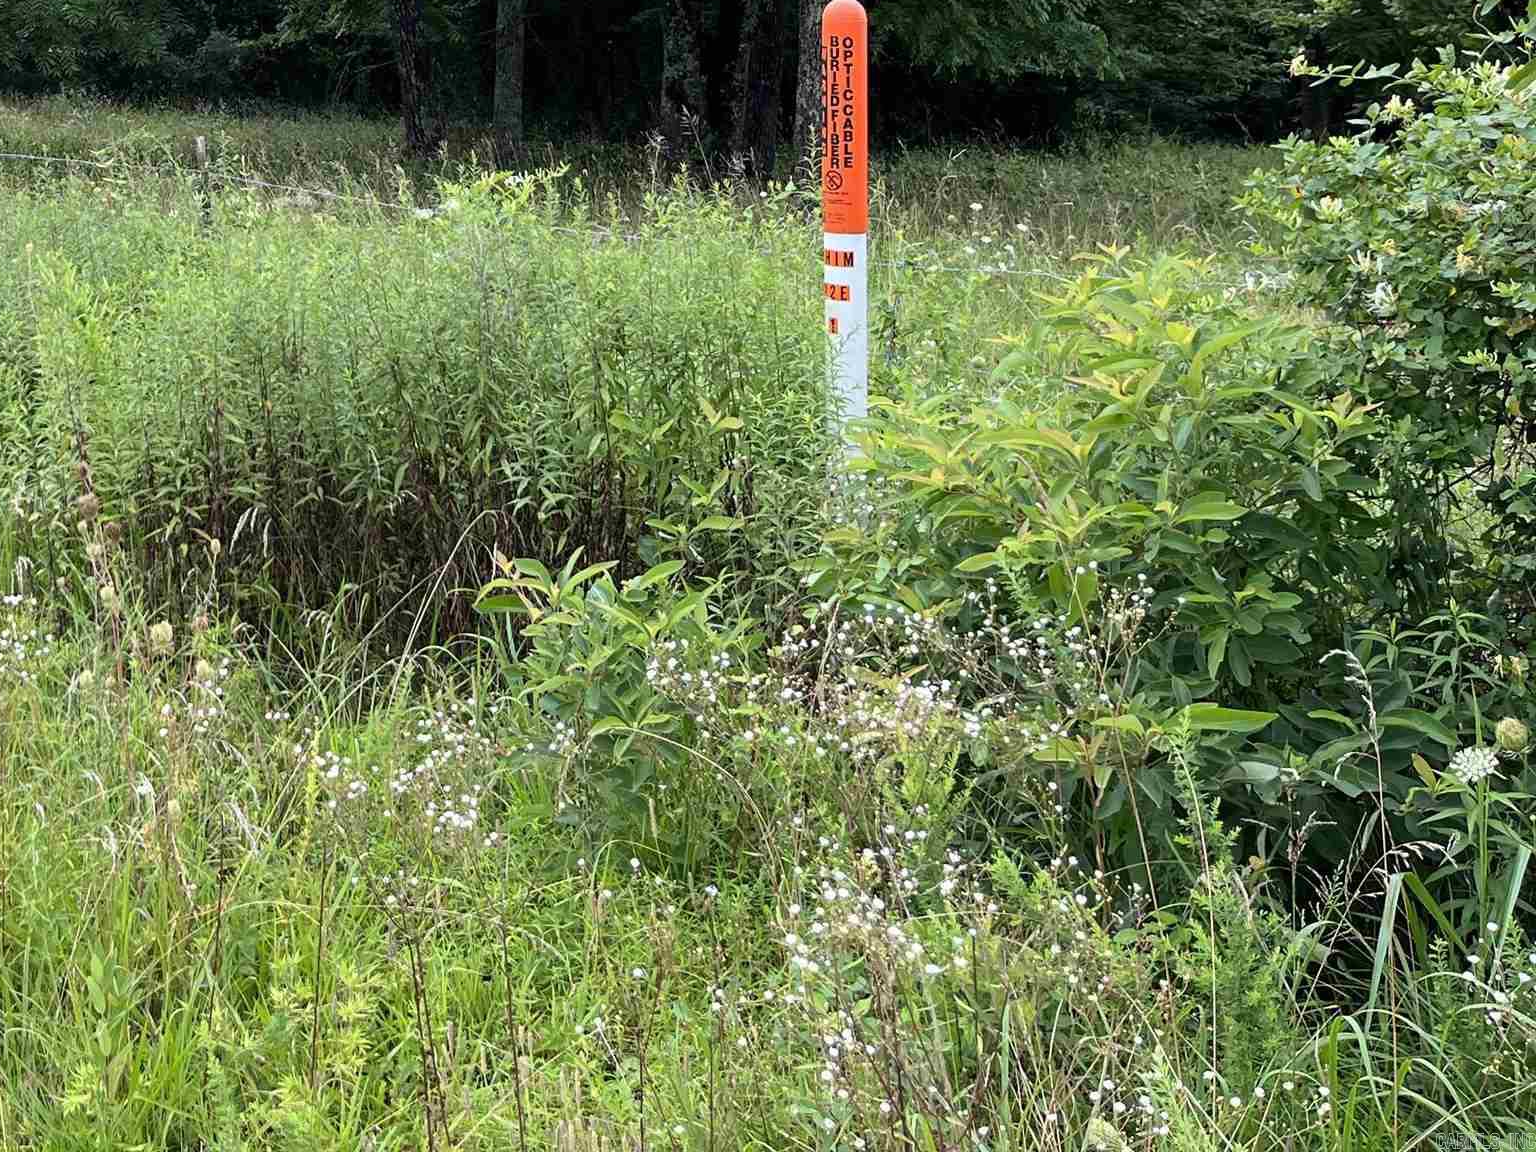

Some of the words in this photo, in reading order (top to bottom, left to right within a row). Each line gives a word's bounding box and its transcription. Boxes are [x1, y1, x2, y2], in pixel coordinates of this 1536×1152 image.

[830, 36, 839, 106] BURIED
[842, 36, 853, 101] OPTIC
[831, 110, 839, 168] FIBER
[843, 105, 853, 168] CABLE
